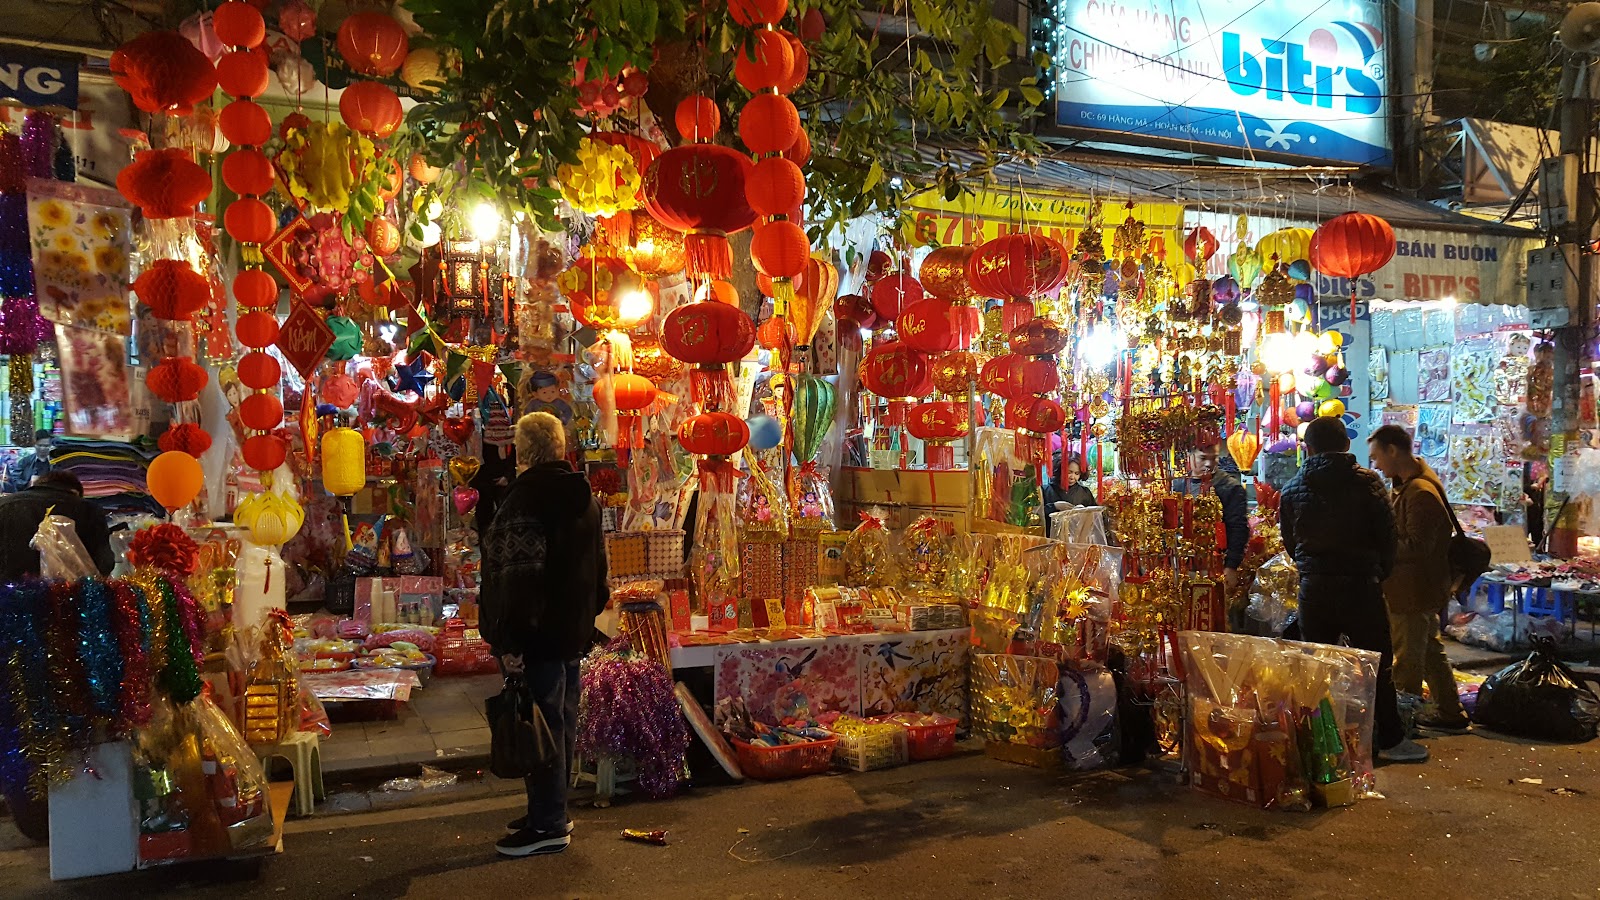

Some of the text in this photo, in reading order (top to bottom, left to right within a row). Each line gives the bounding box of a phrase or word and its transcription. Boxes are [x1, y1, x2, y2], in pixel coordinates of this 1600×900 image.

[1097, 113, 1107, 121] 69
[1108, 113, 1133, 125] HÀNG
[1205, 127, 1216, 137] HÀ
[1218, 129, 1232, 139] NỘI
[1396, 239, 1498, 262] BÁN BUÔN
